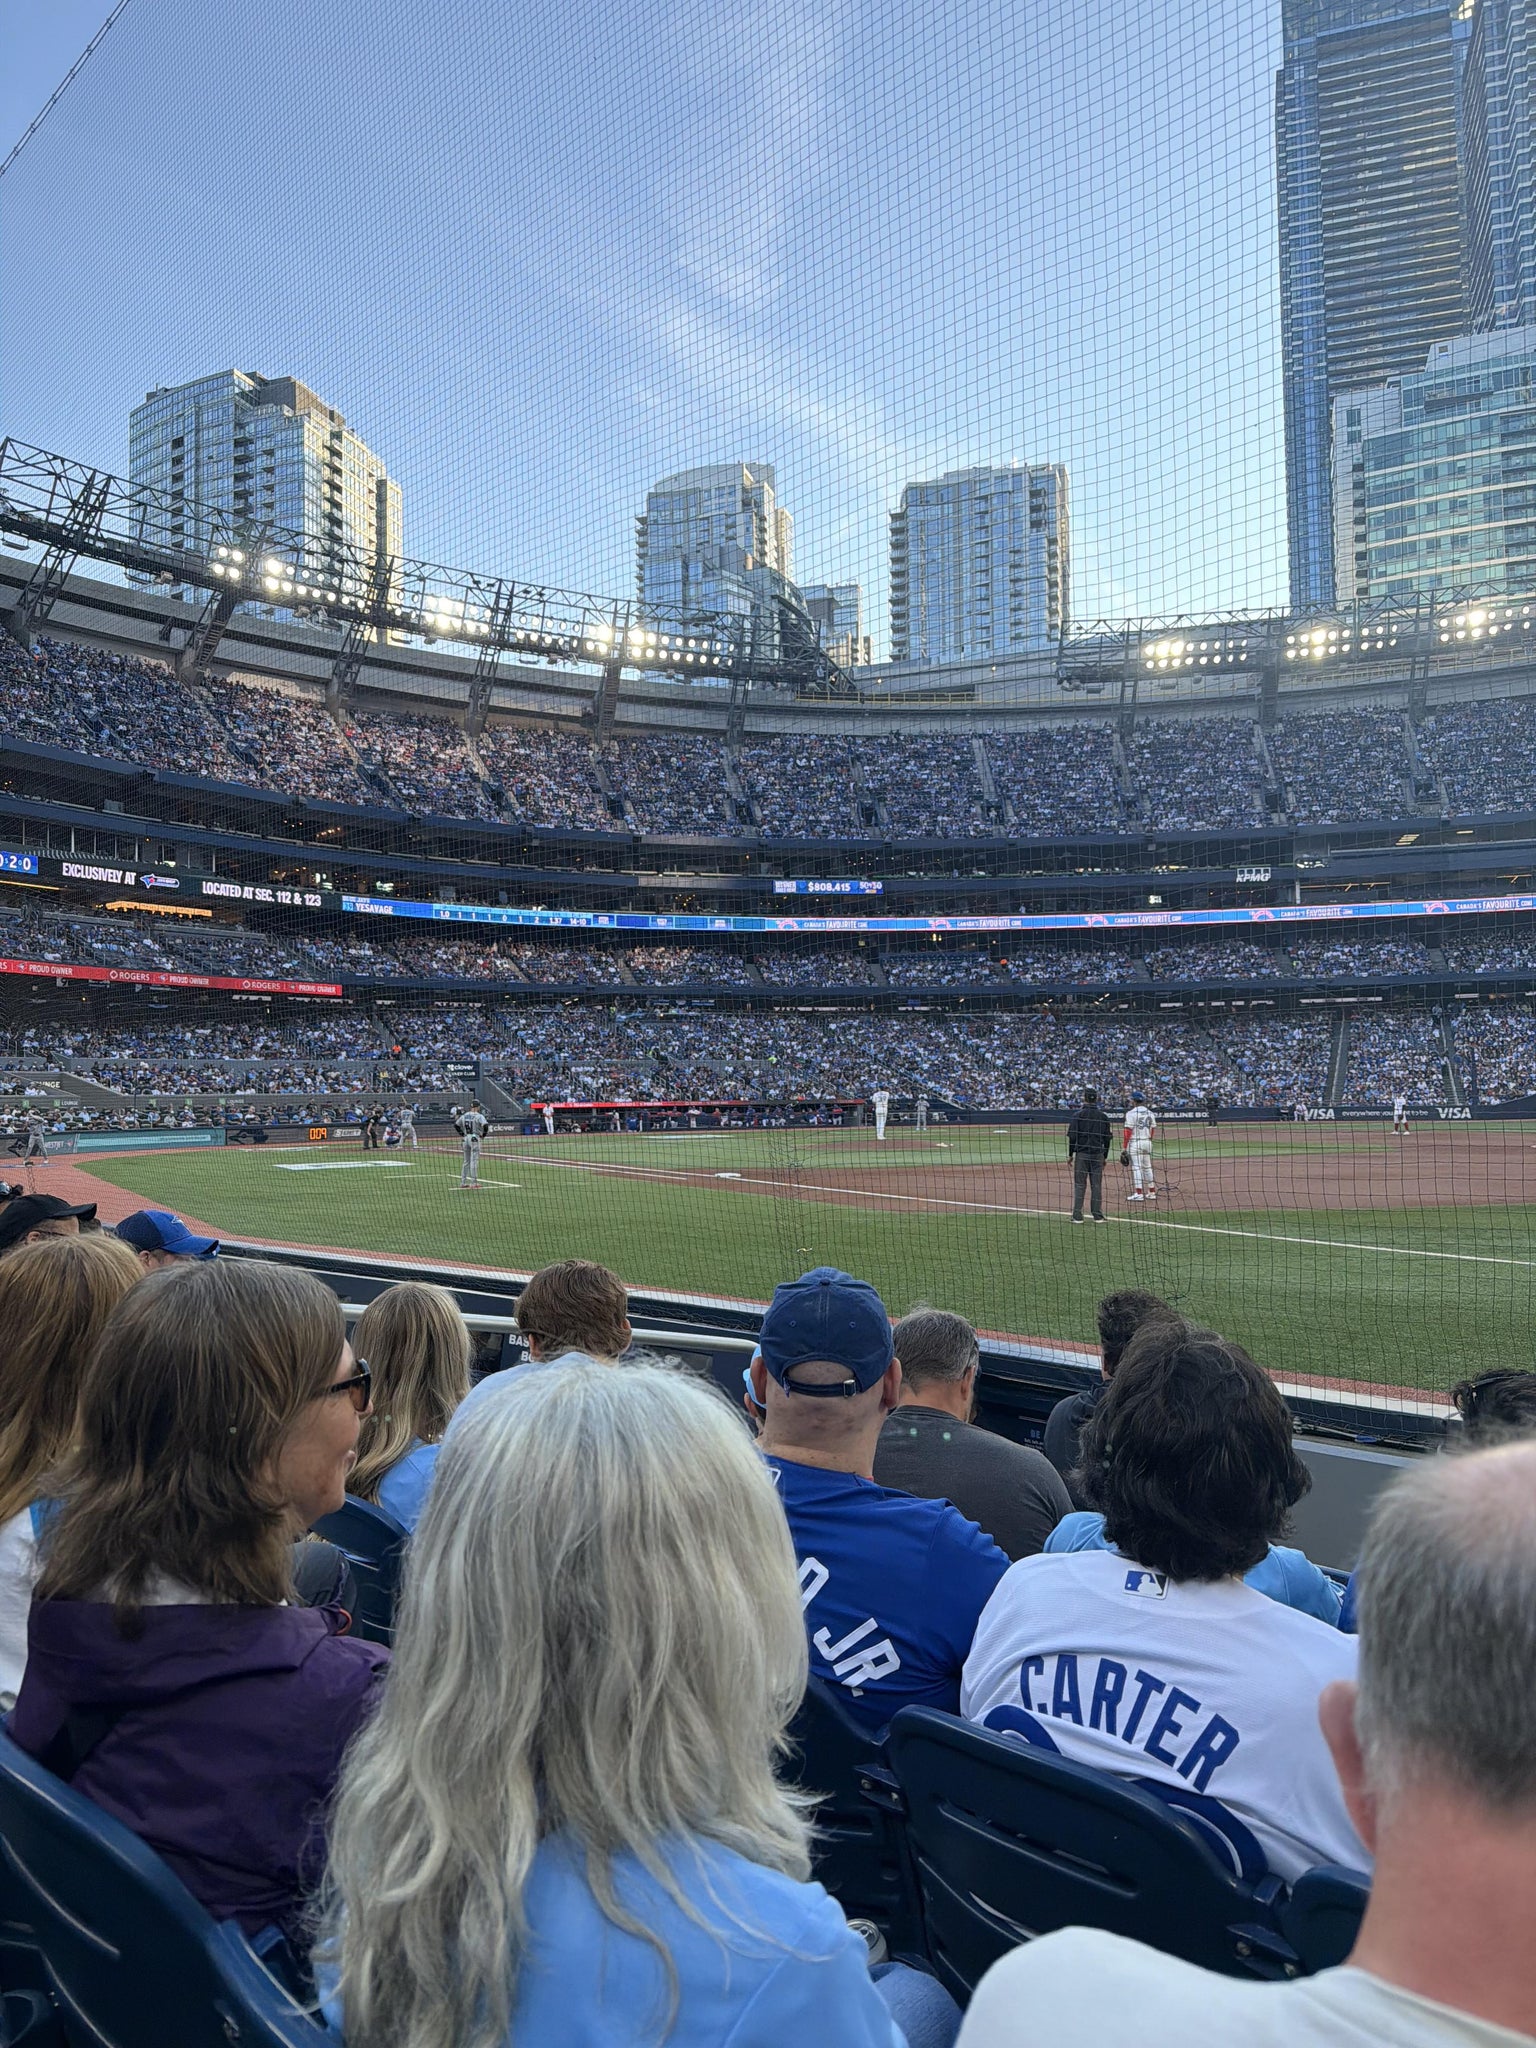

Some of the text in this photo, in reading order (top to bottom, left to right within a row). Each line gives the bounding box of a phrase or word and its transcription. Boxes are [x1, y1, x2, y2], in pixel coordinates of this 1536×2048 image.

[9, 855, 18, 869] 2
[22, 857, 32, 871] 0
[62, 862, 123, 884] EXCLUSIVELY
[124, 872, 137, 886] AT
[1236, 873, 1272, 883] KPMG
[202, 881, 322, 907] LOCATED AT SEC. 112 & 123
[355, 902, 394, 915] YESAVAGE
[1483, 899, 1520, 909] FAVOURITE
[1306, 907, 1341, 917] FAVOURITE
[826, 920, 857, 929] FAVOURITE
[980, 918, 1010, 927] FAVOURITE
[1138, 915, 1171, 924] FAVOURITE
[28, 964, 73, 976] PROUD OWNER
[119, 972, 150, 982] ROGERS
[251, 981, 281, 990] ROGERS
[1306, 1108, 1336, 1120] VISA
[1435, 1107, 1472, 1119] VISA
[493, 1124, 515, 1132] clover
[812, 1617, 901, 1698] JR.
[1019, 1653, 1241, 1795] CARTER
